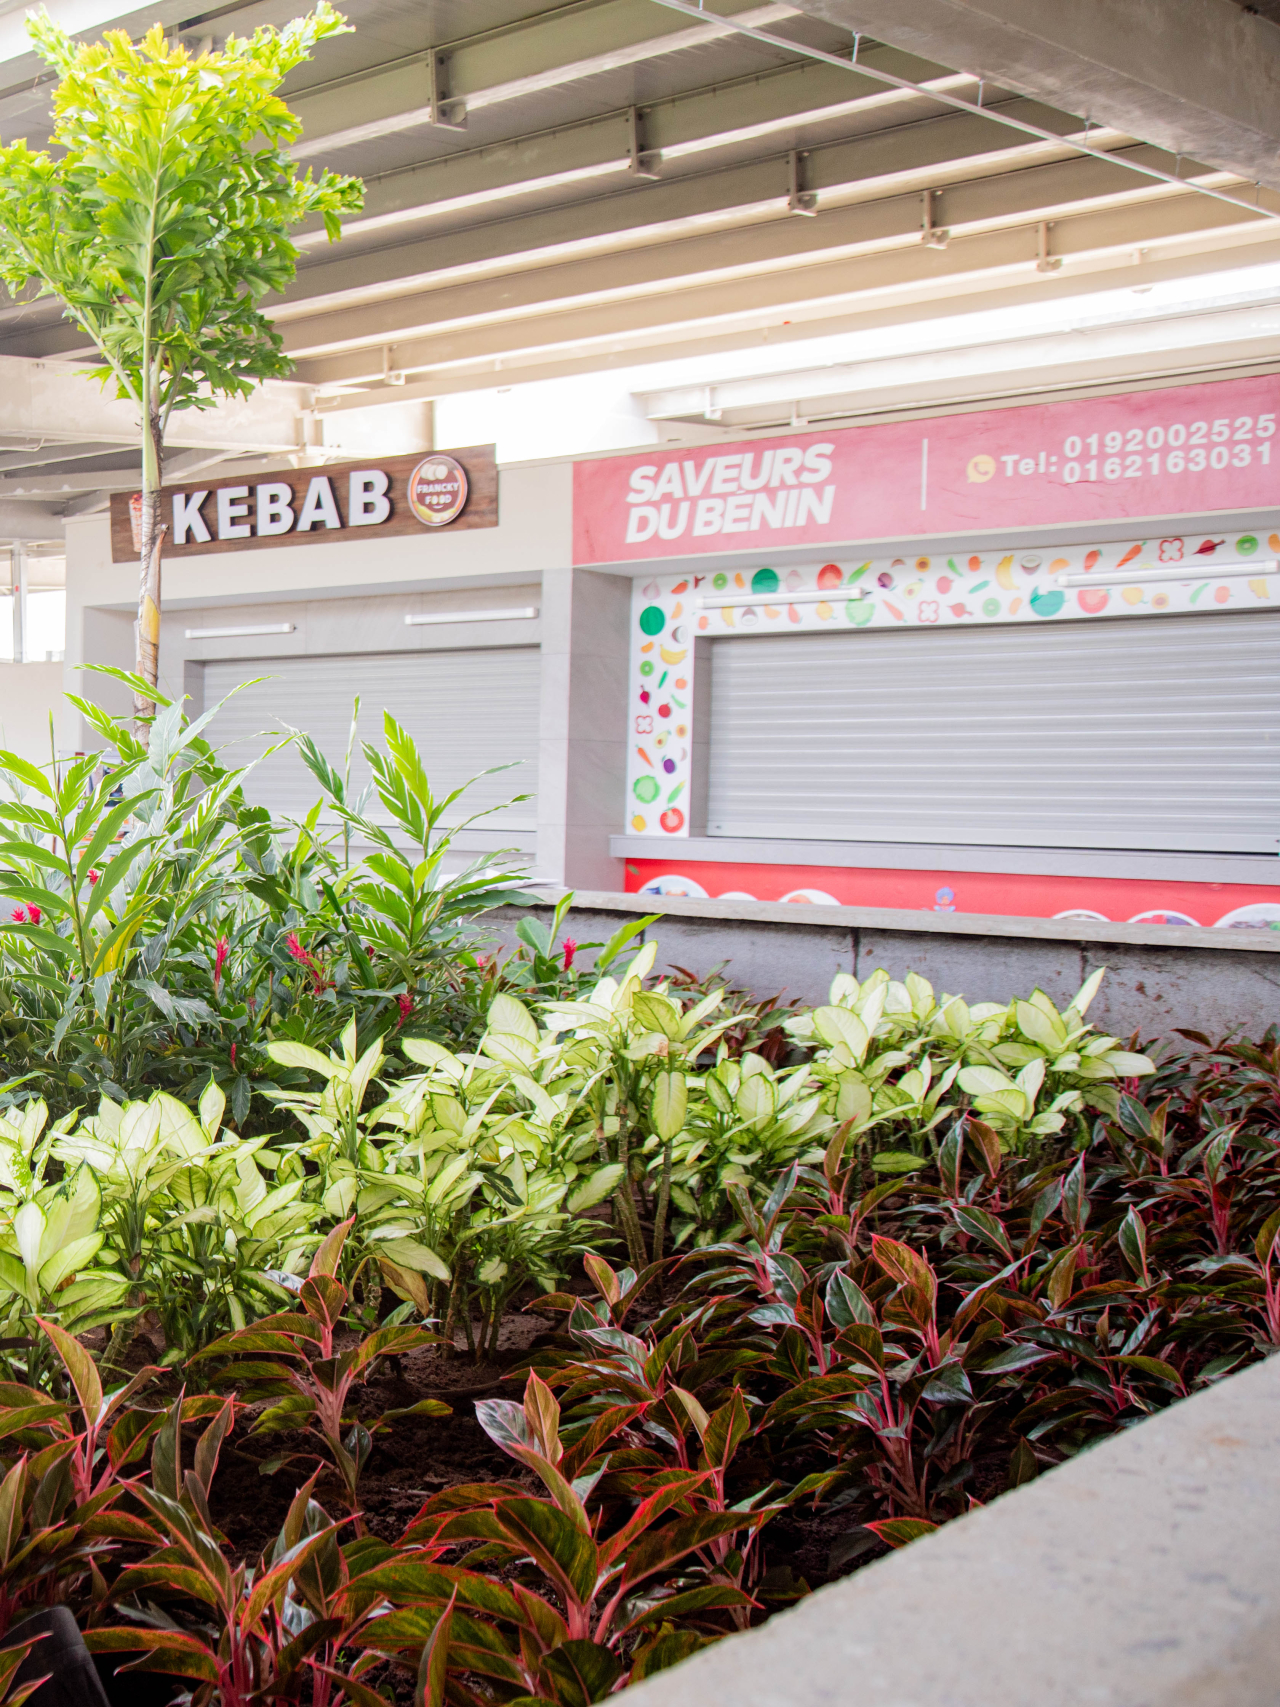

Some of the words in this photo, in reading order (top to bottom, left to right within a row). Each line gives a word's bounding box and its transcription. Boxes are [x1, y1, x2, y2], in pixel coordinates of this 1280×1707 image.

[625, 443, 835, 503] SAVEURS
[1000, 452, 1058, 477] Tel:
[1064, 414, 1276, 458] 0192002525
[1063, 441, 1271, 484] 0162163031
[173, 470, 391, 545] KEBAB
[417, 482, 459, 494] FRANCKY
[425, 494, 452, 505] FOOD
[625, 501, 691, 543] DU
[692, 485, 836, 536] BÉNIN
